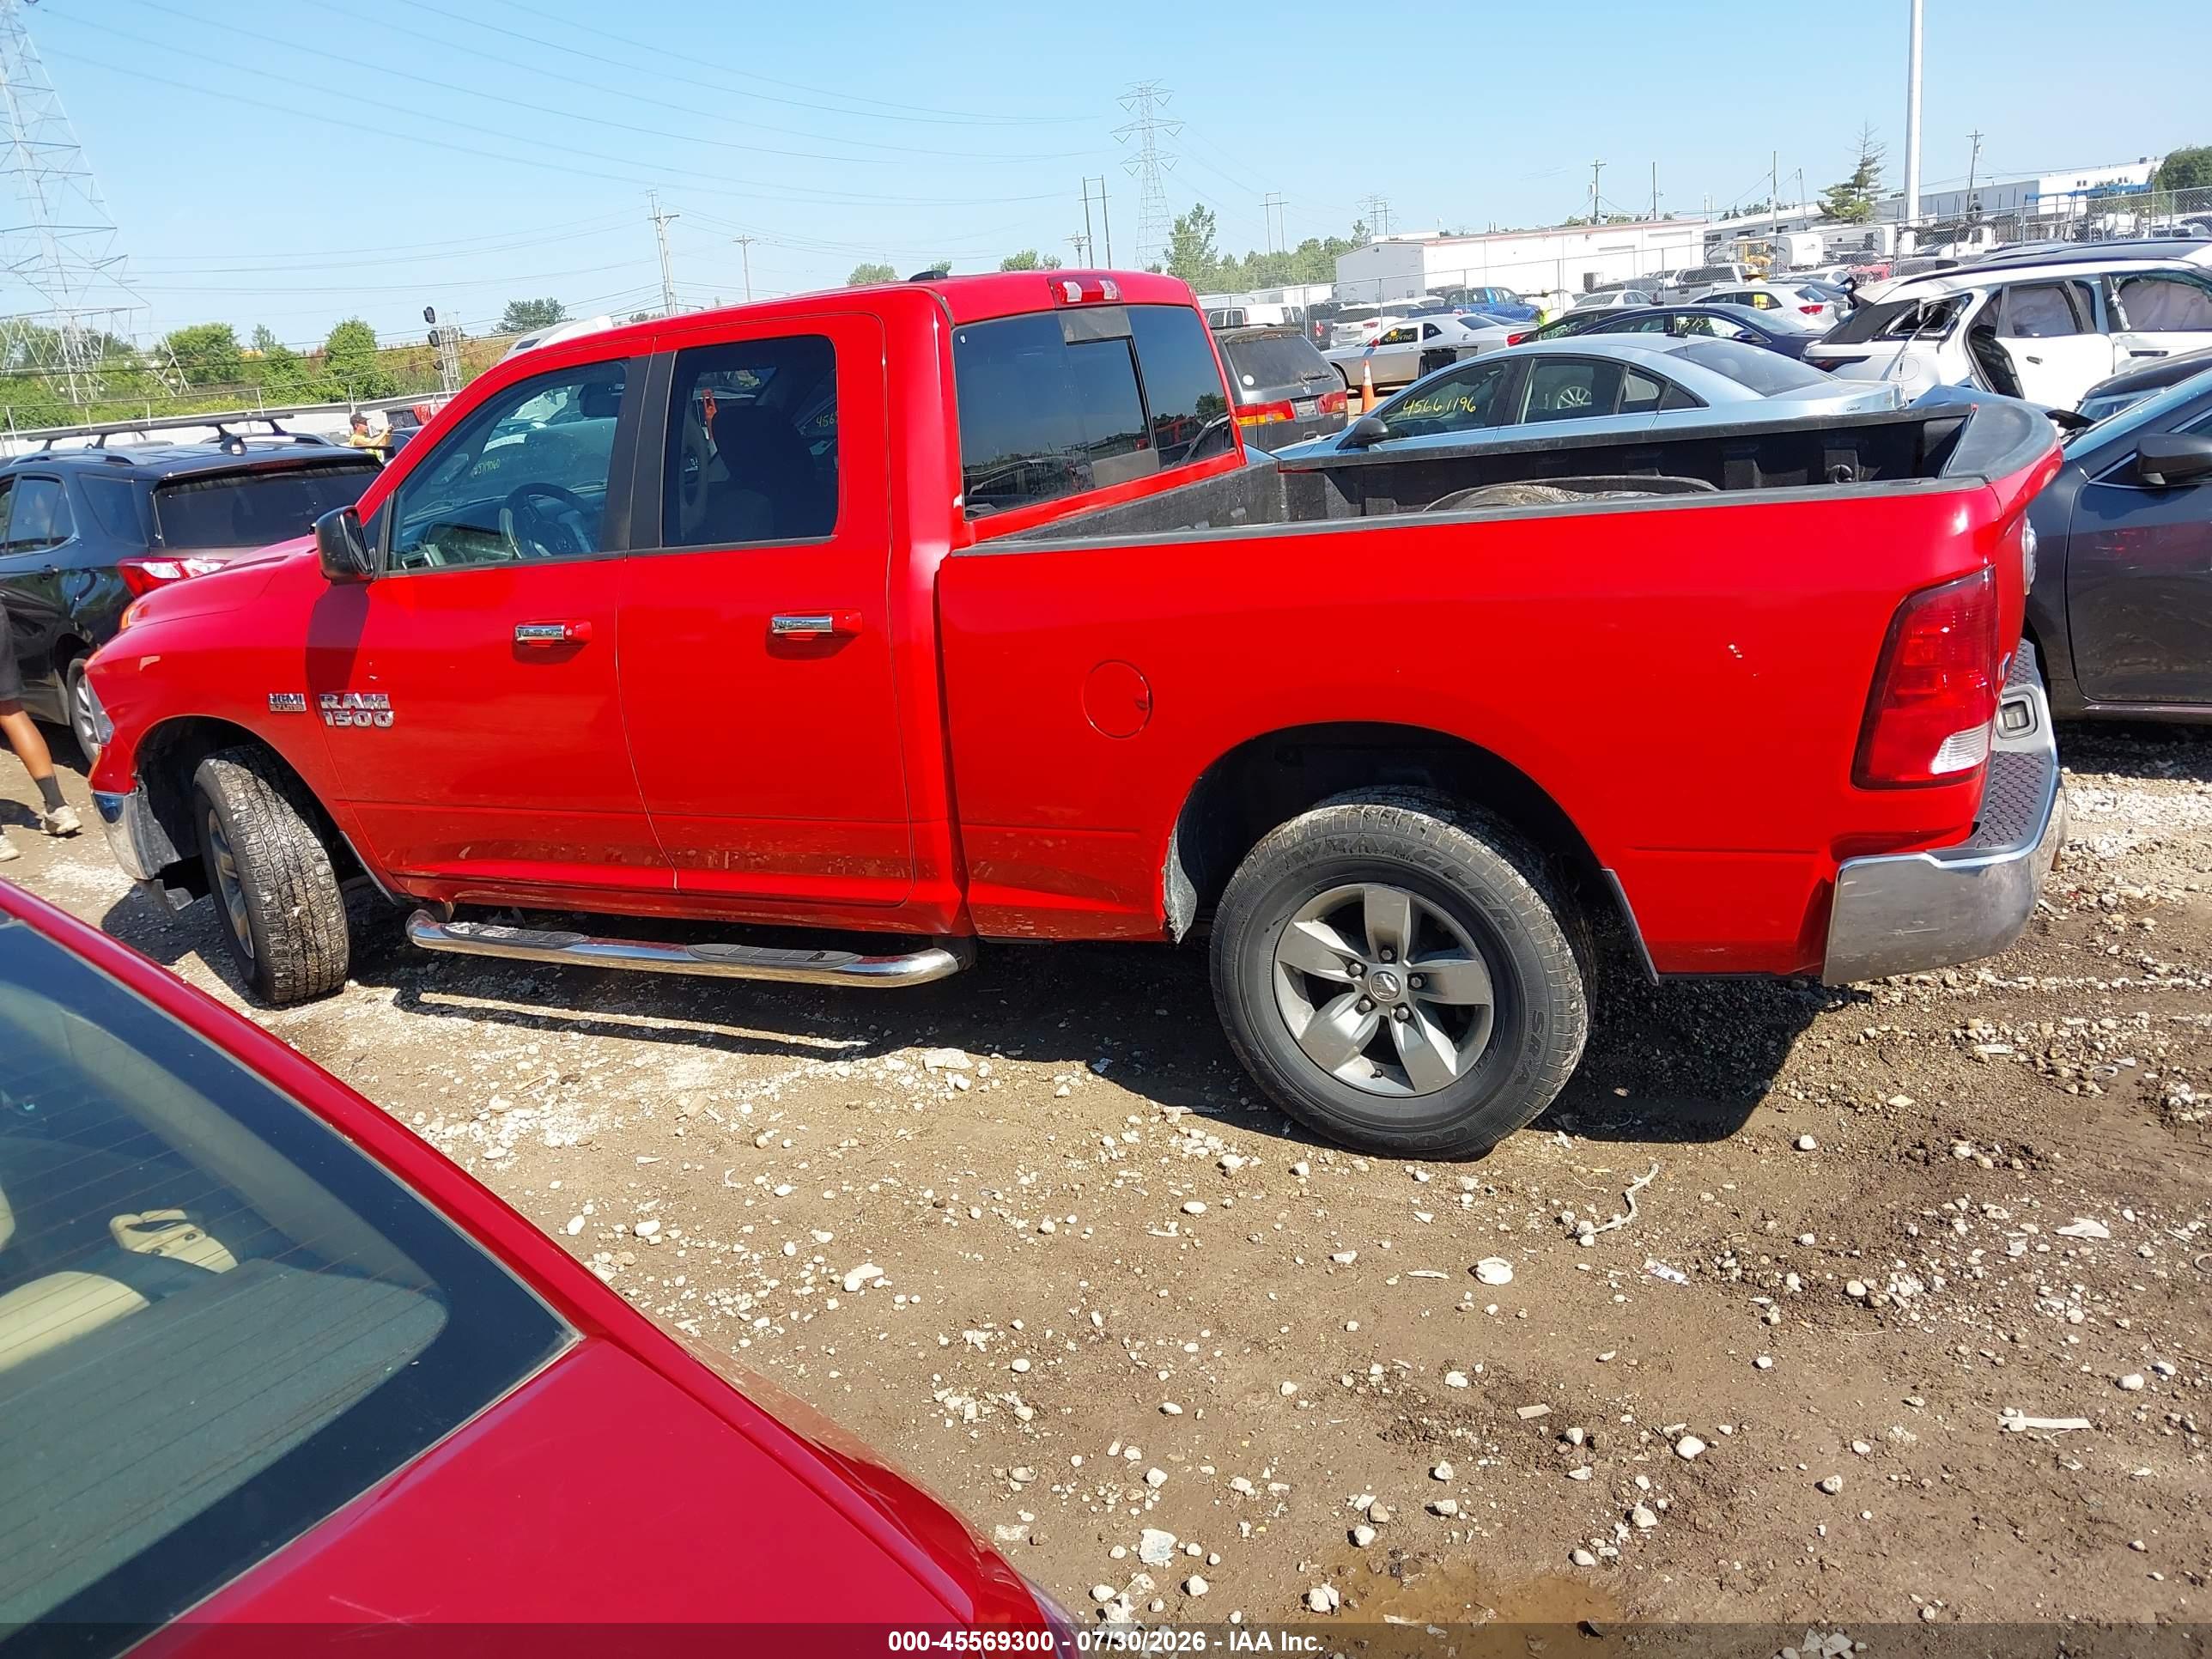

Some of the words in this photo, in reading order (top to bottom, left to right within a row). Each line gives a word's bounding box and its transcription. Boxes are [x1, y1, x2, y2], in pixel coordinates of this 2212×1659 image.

[1402, 396, 1477, 416] 45661196
[817, 411, 838, 427] 456
[319, 693, 392, 709] RAM
[323, 711, 394, 727] 1500
[1290, 835, 1518, 932] WRANGLER
